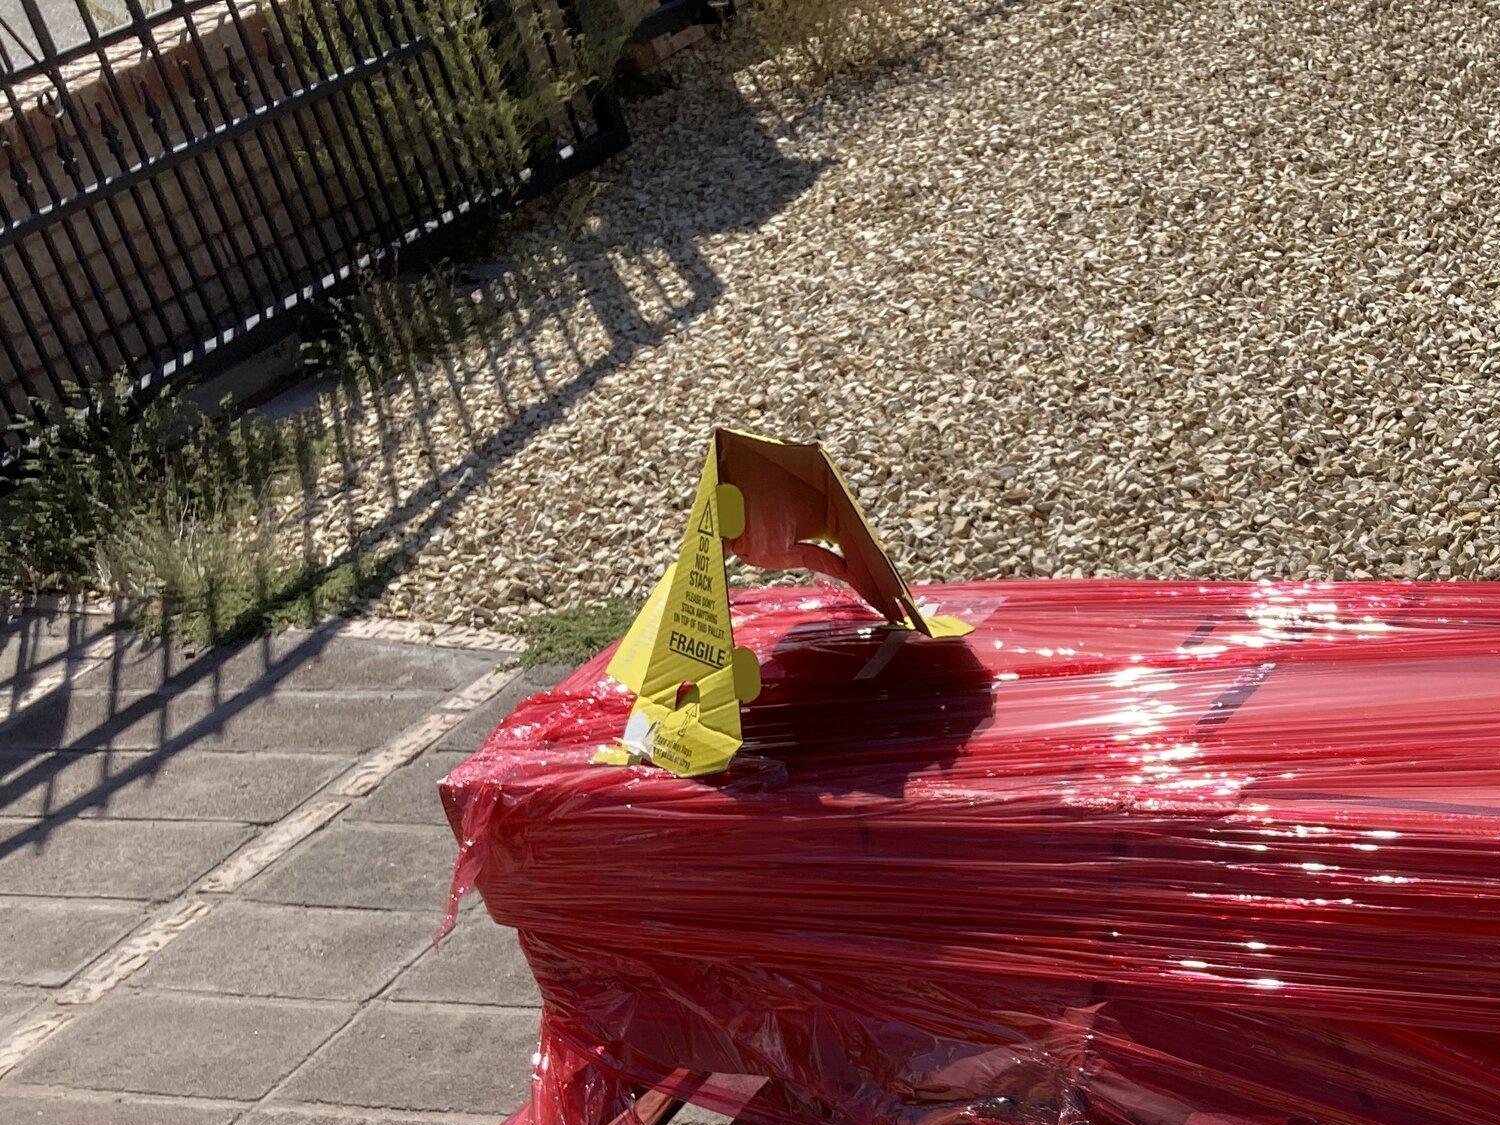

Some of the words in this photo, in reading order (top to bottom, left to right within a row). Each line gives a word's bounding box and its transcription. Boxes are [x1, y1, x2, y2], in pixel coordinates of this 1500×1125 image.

[699, 535, 710, 553] DO
[695, 553, 710, 573] NOT
[689, 570, 712, 593] STACK
[685, 591, 702, 605] PLEASE
[702, 596, 716, 610] DON'T
[673, 612, 681, 623] ON
[681, 614, 690, 627] TOP
[697, 620, 708, 634] THIS
[681, 602, 696, 615] STACK
[696, 607, 718, 625] ANYTHING
[669, 631, 726, 667] FRAGILE
